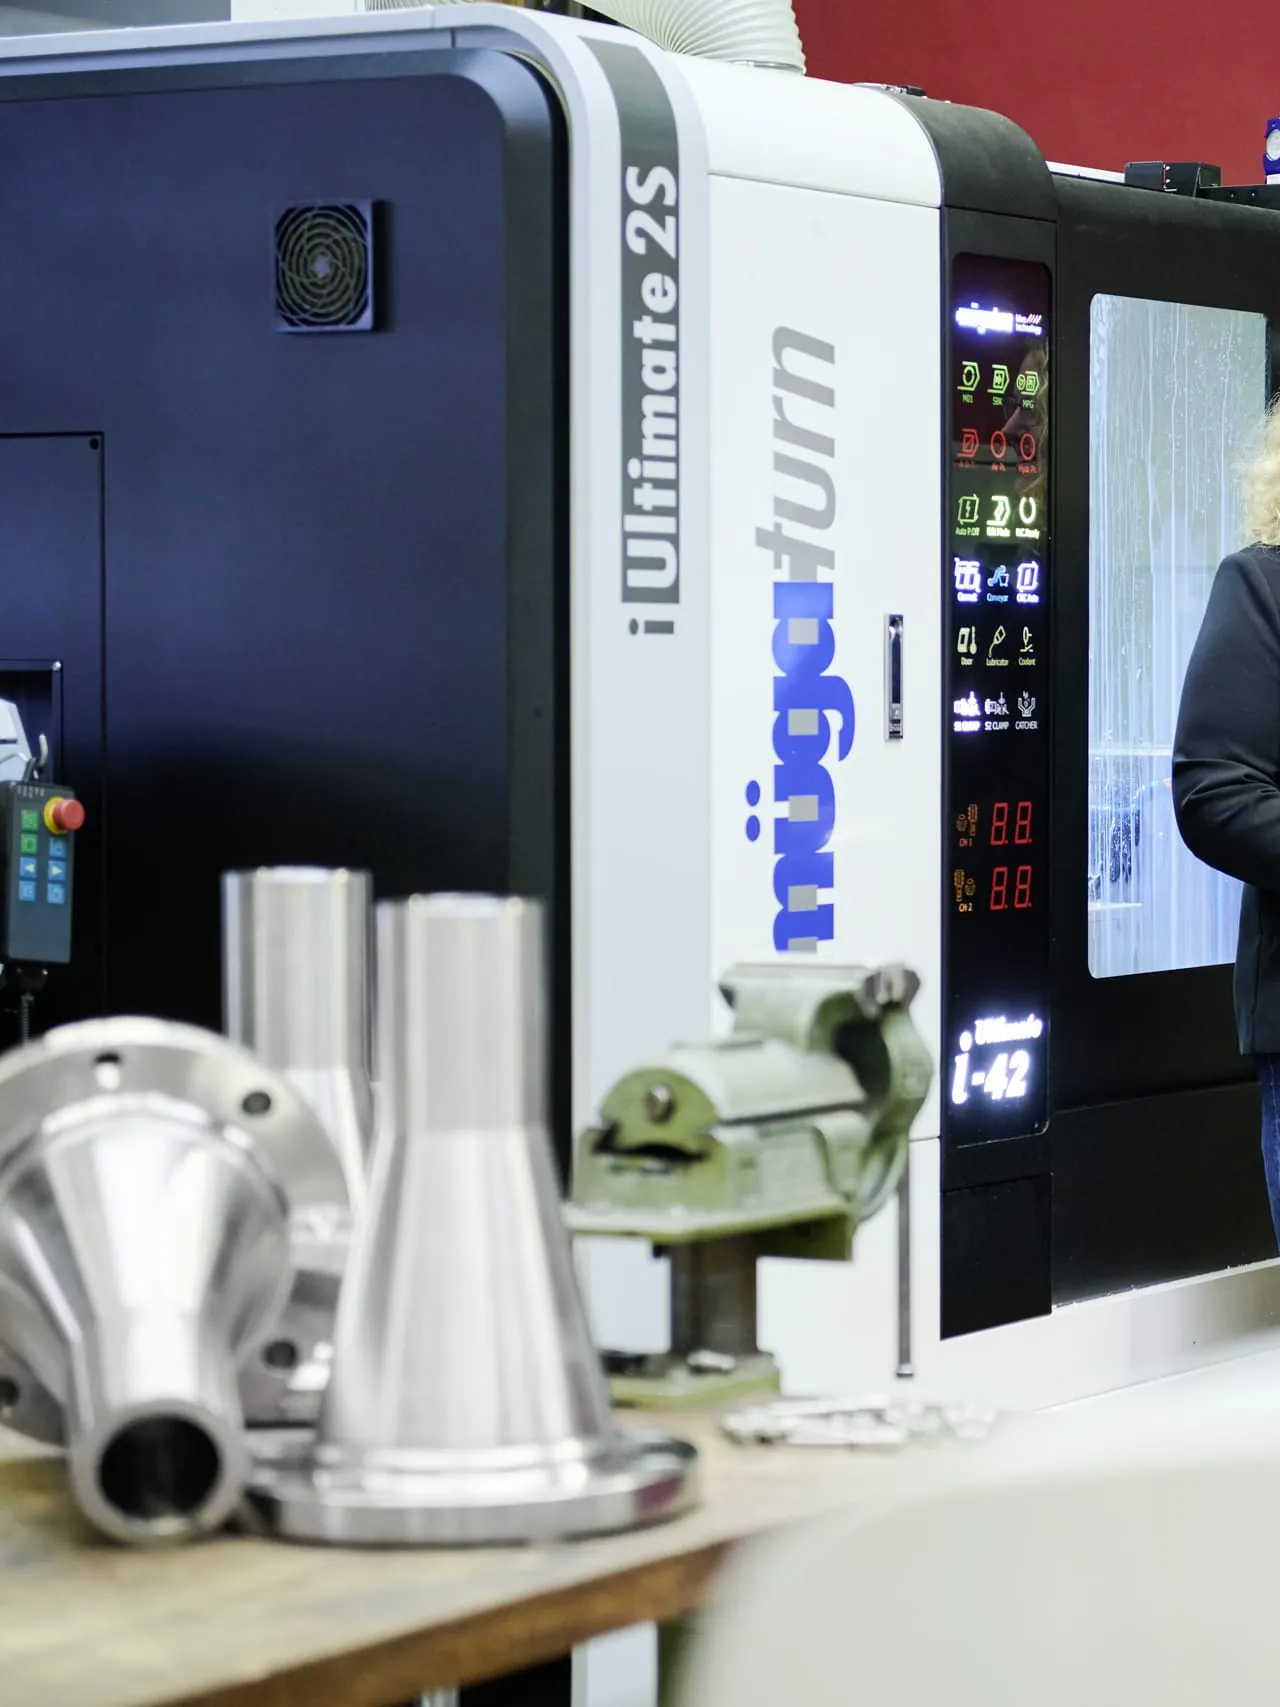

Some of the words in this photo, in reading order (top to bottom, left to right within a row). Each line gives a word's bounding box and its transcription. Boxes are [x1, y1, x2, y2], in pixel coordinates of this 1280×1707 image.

[625, 164, 678, 260] 2S
[625, 272, 678, 590] Ultimate
[628, 617, 676, 636] i
[1015, 721, 1038, 730] CATCHER
[952, 1031, 1030, 1104] i-42
